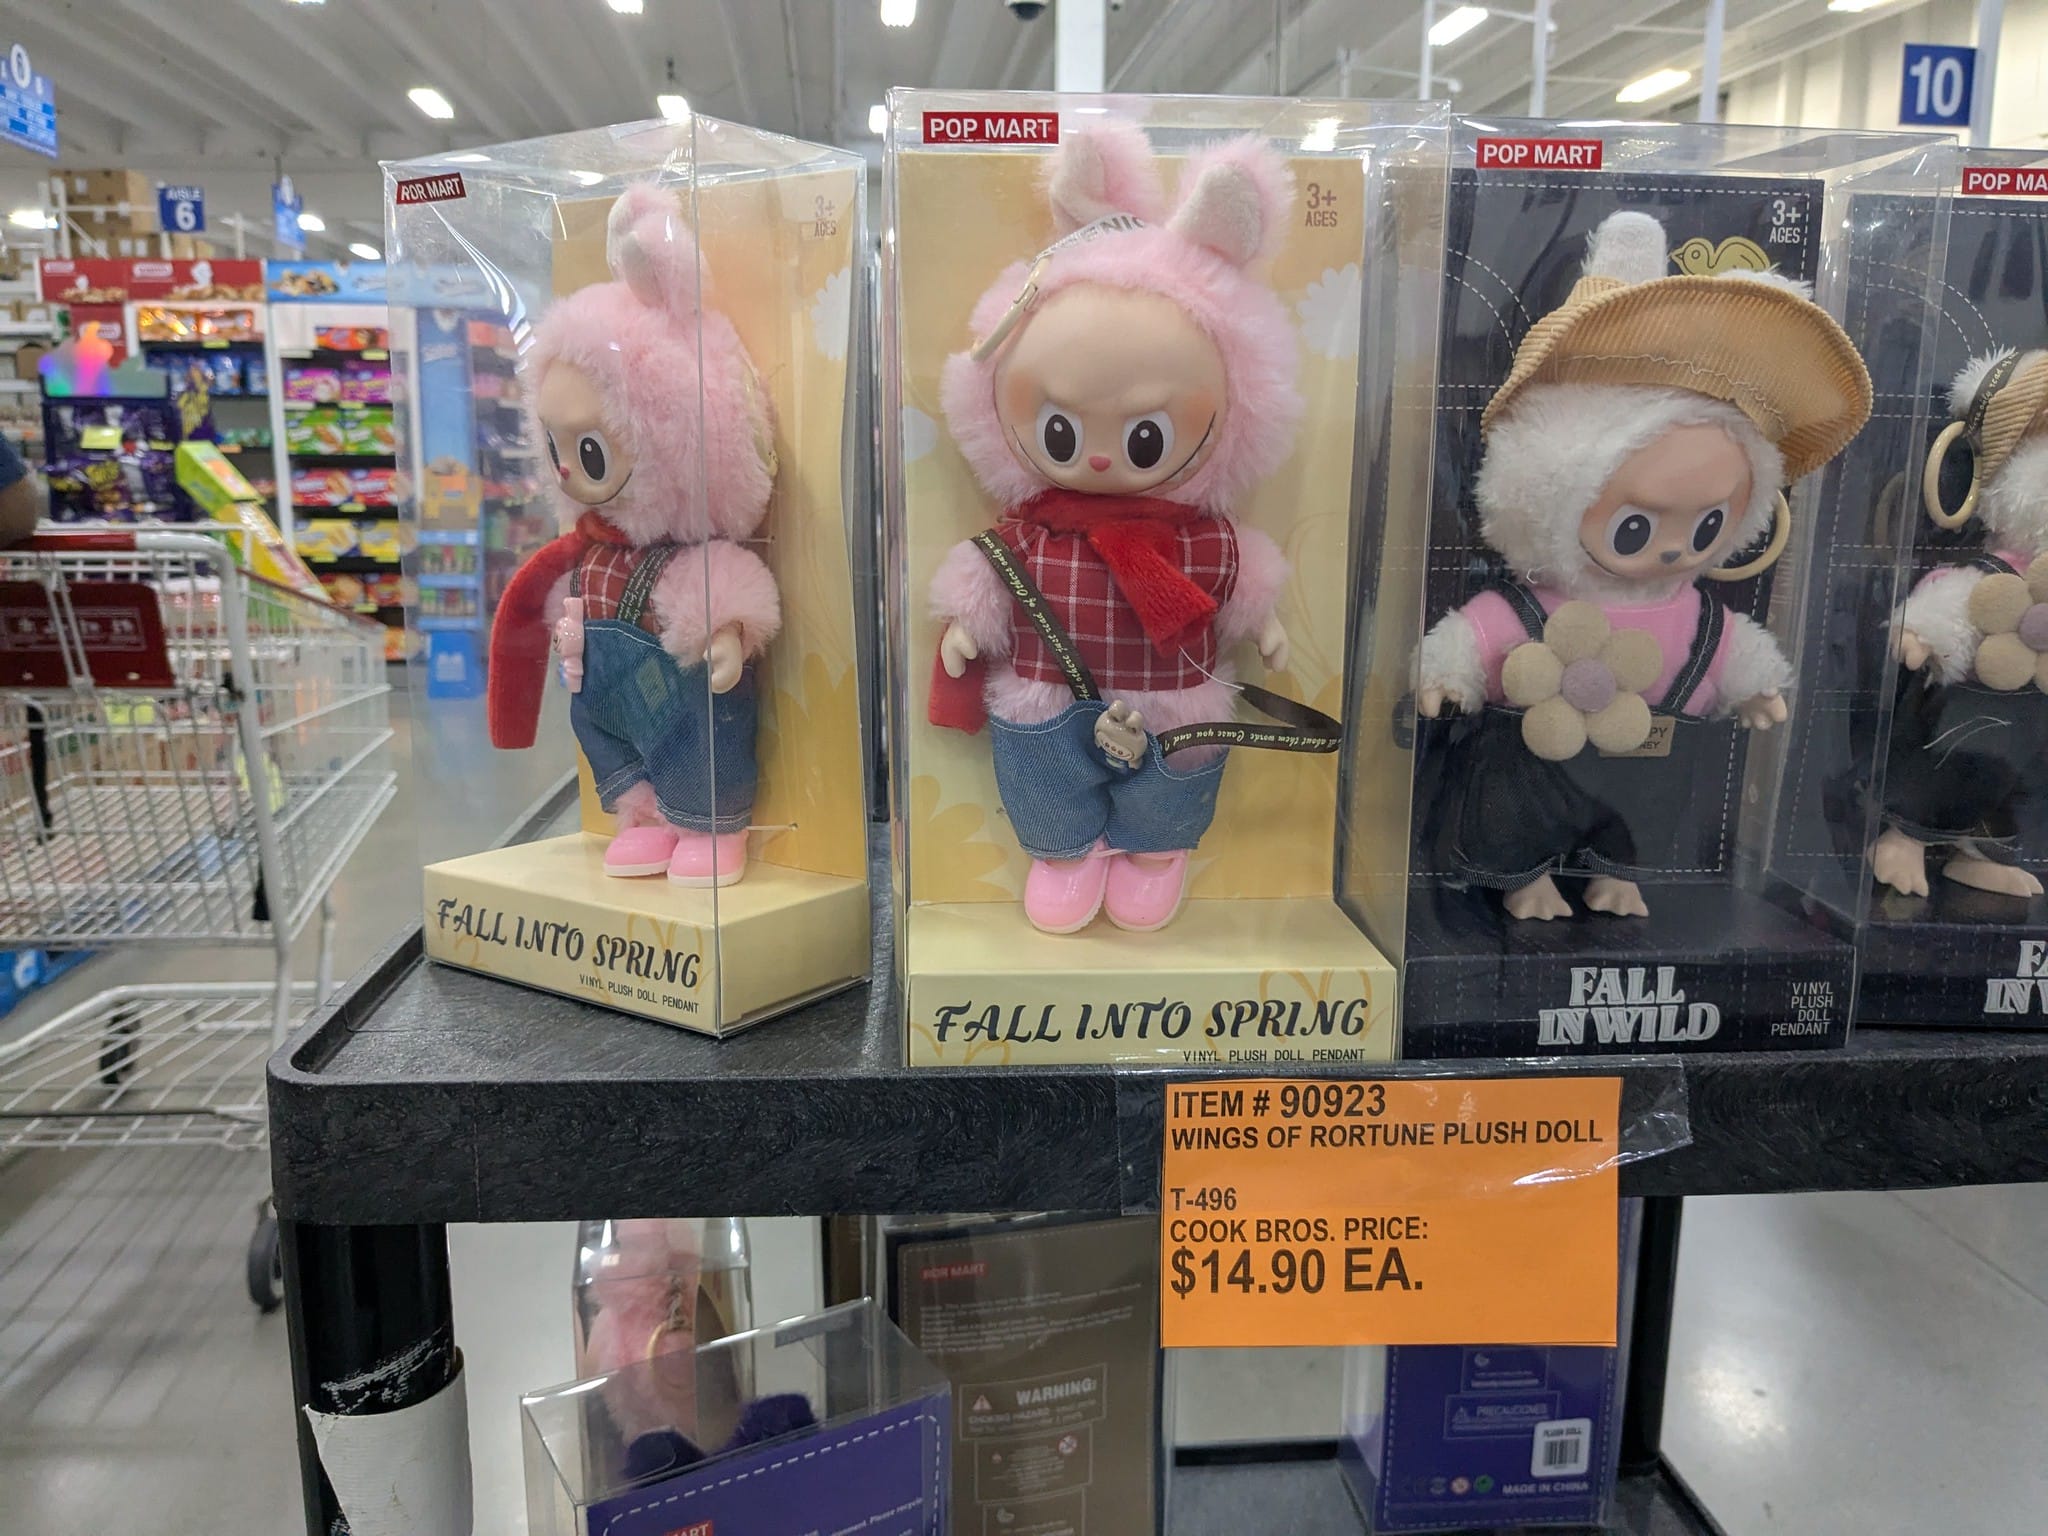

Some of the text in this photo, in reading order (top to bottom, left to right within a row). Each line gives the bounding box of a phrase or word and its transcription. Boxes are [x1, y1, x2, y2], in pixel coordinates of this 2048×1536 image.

[1909, 56, 1963, 118] 10
[930, 118, 1053, 138] POP MART
[1484, 144, 1597, 164] POP MART
[425, 178, 461, 198] MART
[1968, 173, 2048, 191] POP MA
[1307, 183, 1337, 209] 3+
[175, 201, 196, 230] 6
[1305, 211, 1338, 227] AGES
[1772, 199, 1801, 226] 3+
[1769, 227, 1801, 243] AGES
[437, 897, 701, 989] FALL INTO SPRING
[579, 974, 699, 1014] VINYL PLUSH DOLL PENDANT
[1568, 966, 1686, 1007] FALL
[1793, 982, 1834, 995] VINYL
[1983, 978, 2036, 1014] IN
[1790, 996, 1833, 1009] PLUSH
[933, 996, 1369, 1043] FALL INTO SPRING
[1797, 1009, 1831, 1022] DOLL
[1771, 1022, 1830, 1036] PENDANT
[1183, 1048, 1366, 1063] VINYL PLUSH DOLL PENDANT
[1172, 1085, 1386, 1118] ITEM # 90923
[1171, 1119, 1603, 1150] WINGS OF RORTUNE PLUSH DOLL
[1170, 1187, 1237, 1212] T-496
[1170, 1216, 1428, 1243] COOK BROS. PRICE:
[1170, 1245, 1423, 1299] $14.90 EA.
[1502, 1483, 1536, 1495] MADE
